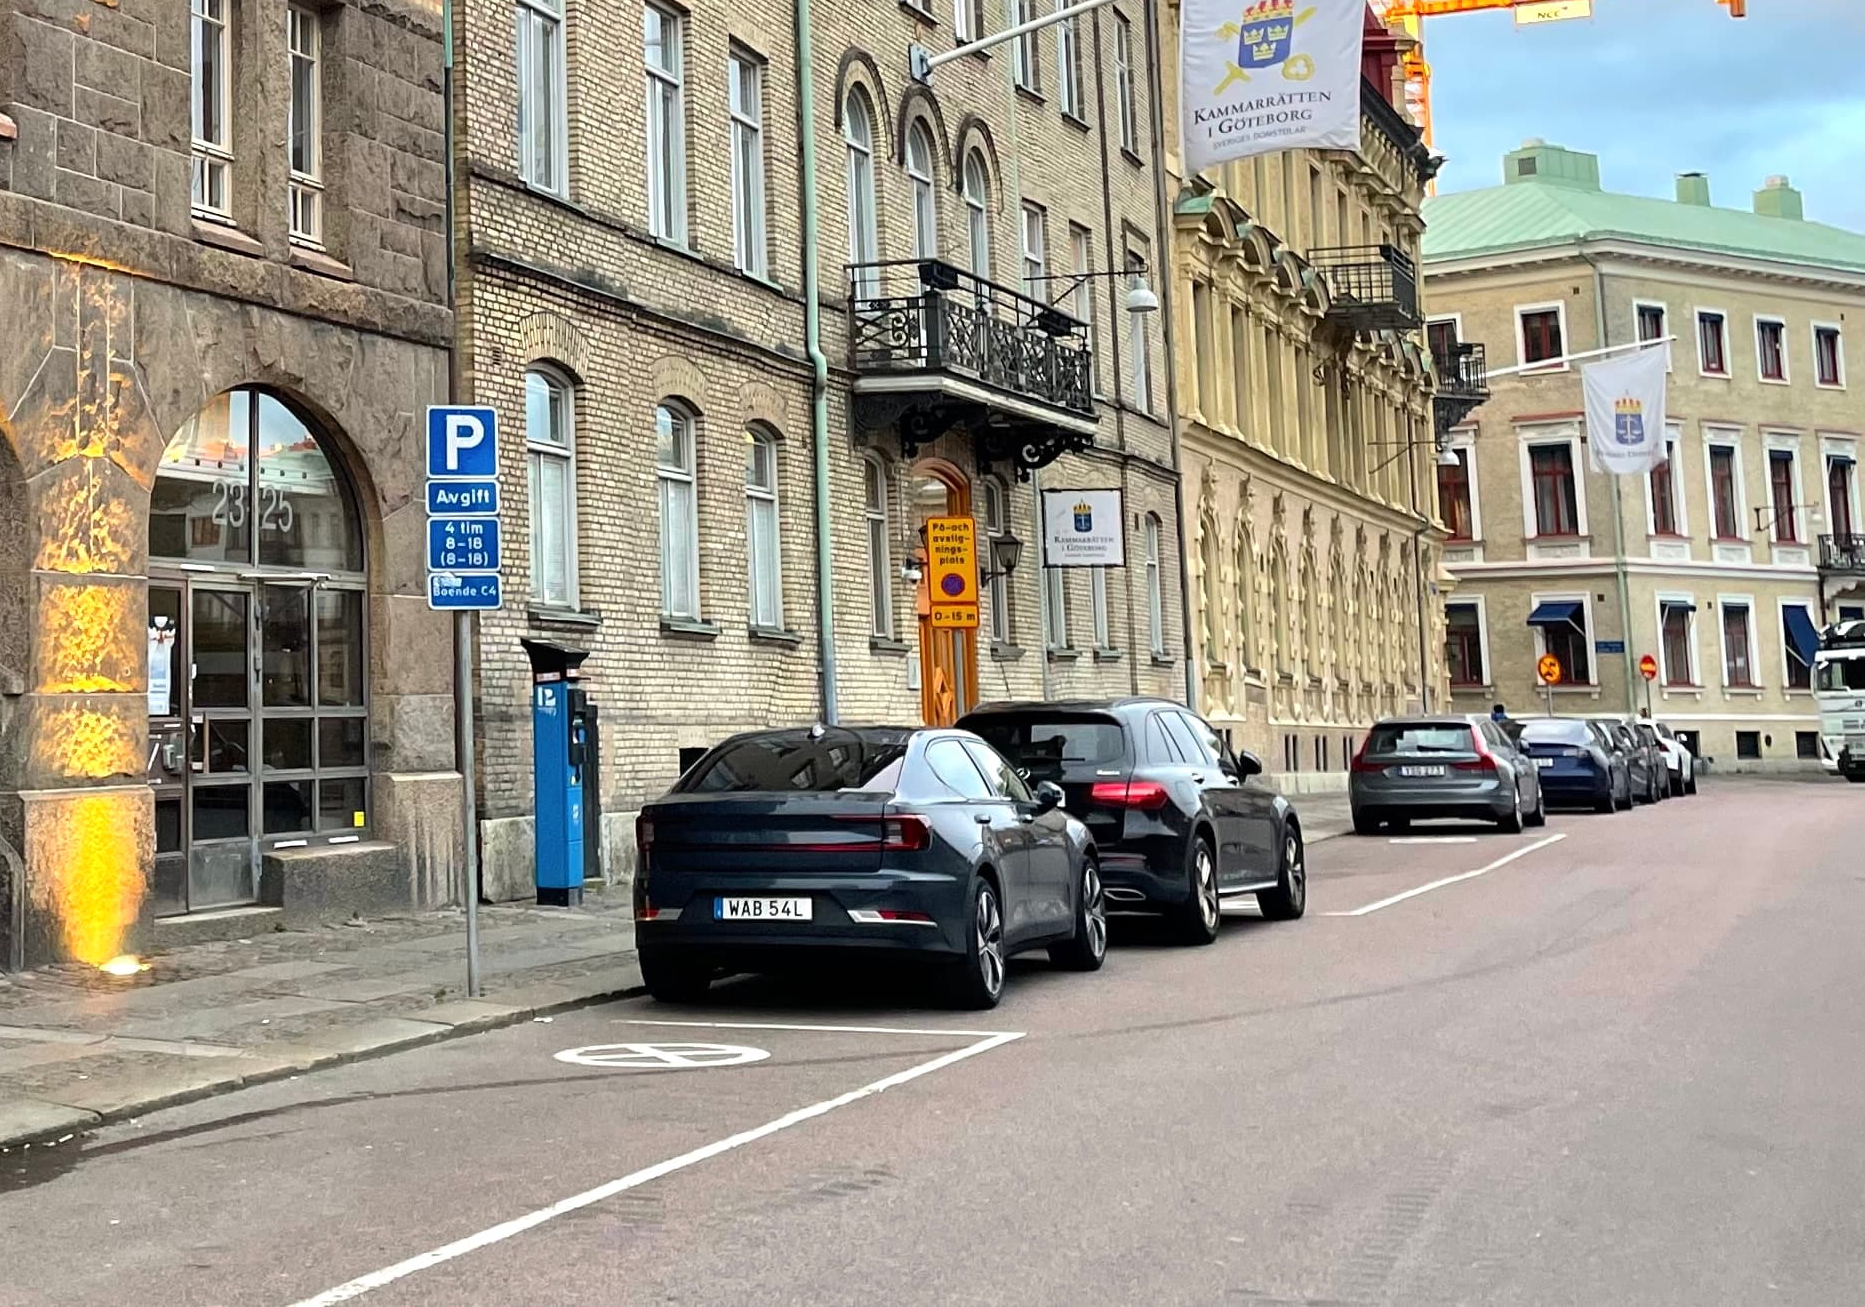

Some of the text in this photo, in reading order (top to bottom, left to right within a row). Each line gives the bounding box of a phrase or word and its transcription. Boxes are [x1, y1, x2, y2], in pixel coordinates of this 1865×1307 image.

[1194, 91, 1332, 126] KAMMARRÄTTEN
[1218, 109, 1313, 134] GÖTEBORG
[446, 414, 485, 471] P
[436, 489, 490, 507] Avgift
[445, 521, 483, 534] 4 tim
[445, 537, 483, 549] 8-18
[440, 551, 488, 566] (8-18)
[433, 585, 496, 597] Boende C4
[966, 613, 975, 621] m
[728, 900, 803, 917] WAB 54L
